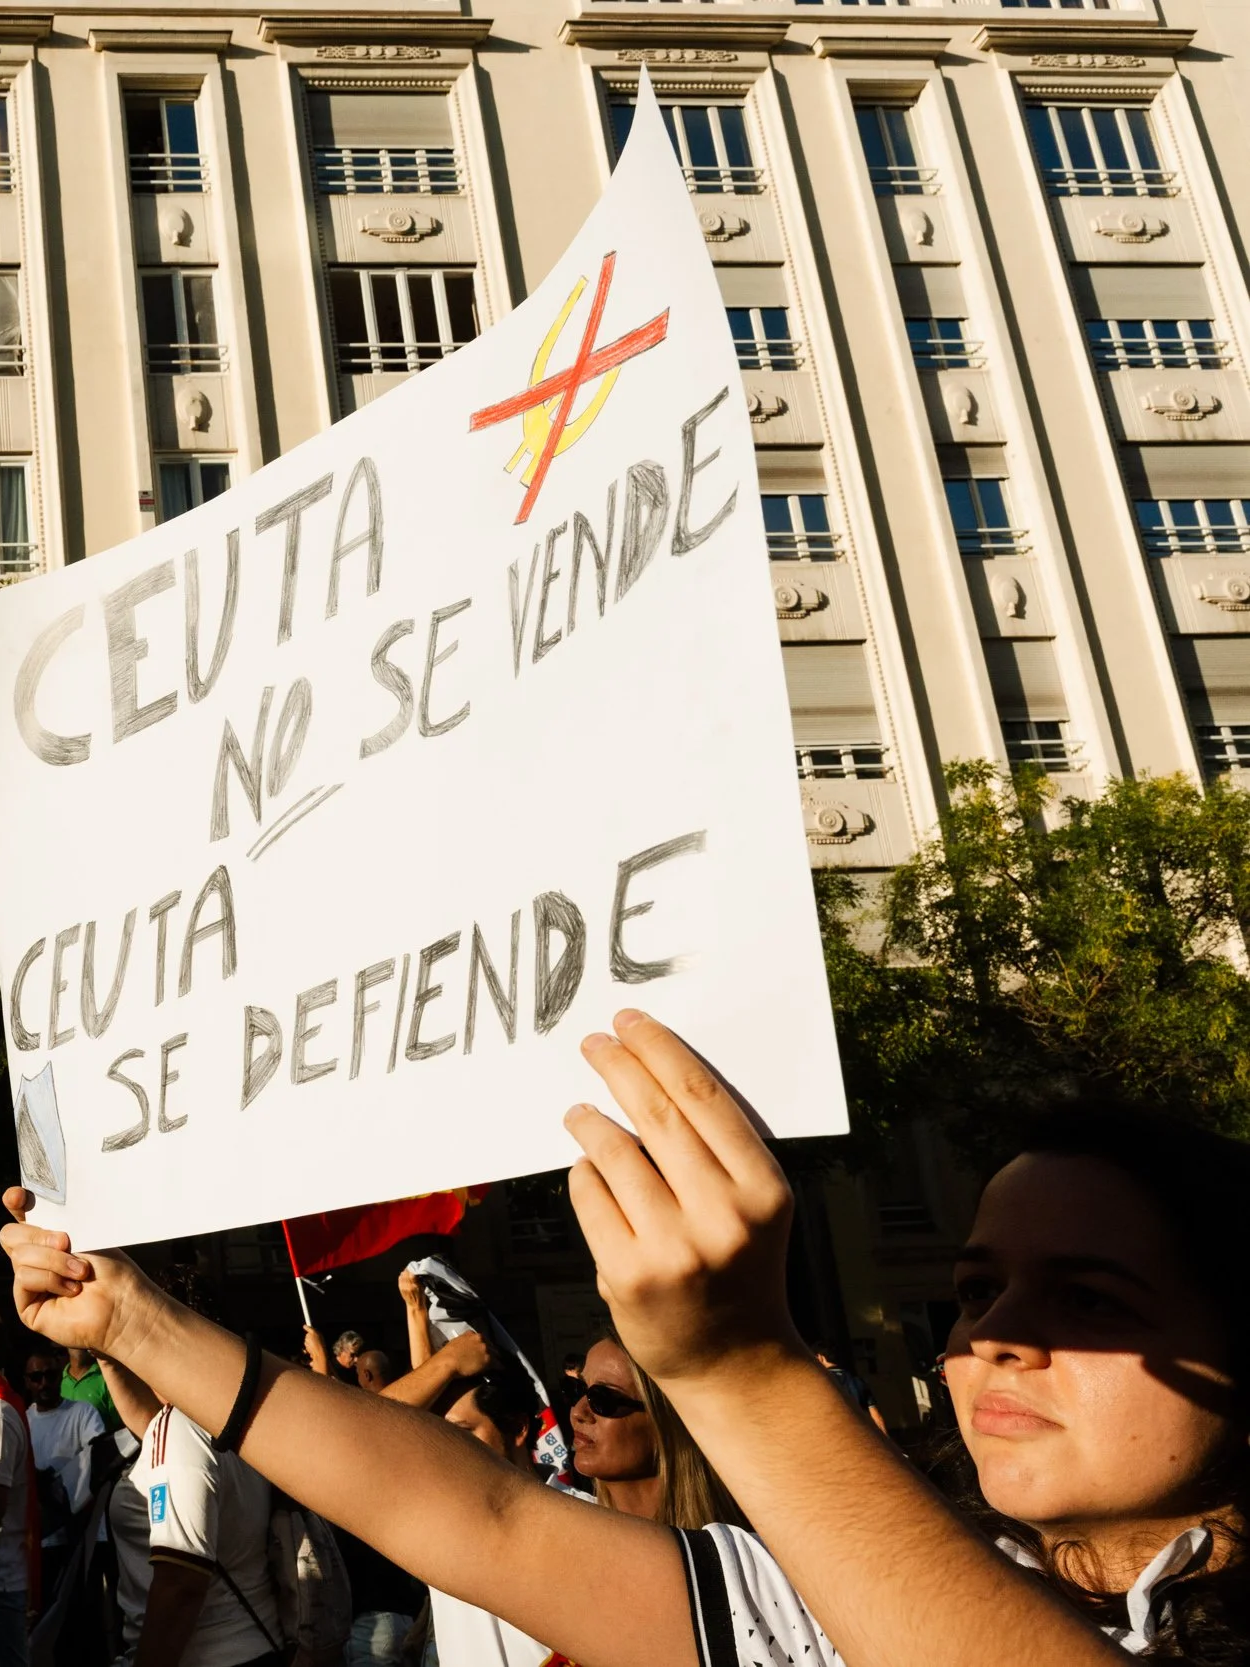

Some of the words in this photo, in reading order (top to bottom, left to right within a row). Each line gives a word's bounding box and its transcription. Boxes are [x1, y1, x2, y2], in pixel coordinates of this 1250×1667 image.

[14, 456, 386, 767] CEUTA
[210, 676, 314, 842] NO
[358, 596, 473, 760] SE
[506, 386, 740, 679] VENDE
[10, 864, 238, 1052] CEUTA
[101, 1031, 189, 1153] SE
[240, 829, 708, 1112] DEFIENDE
